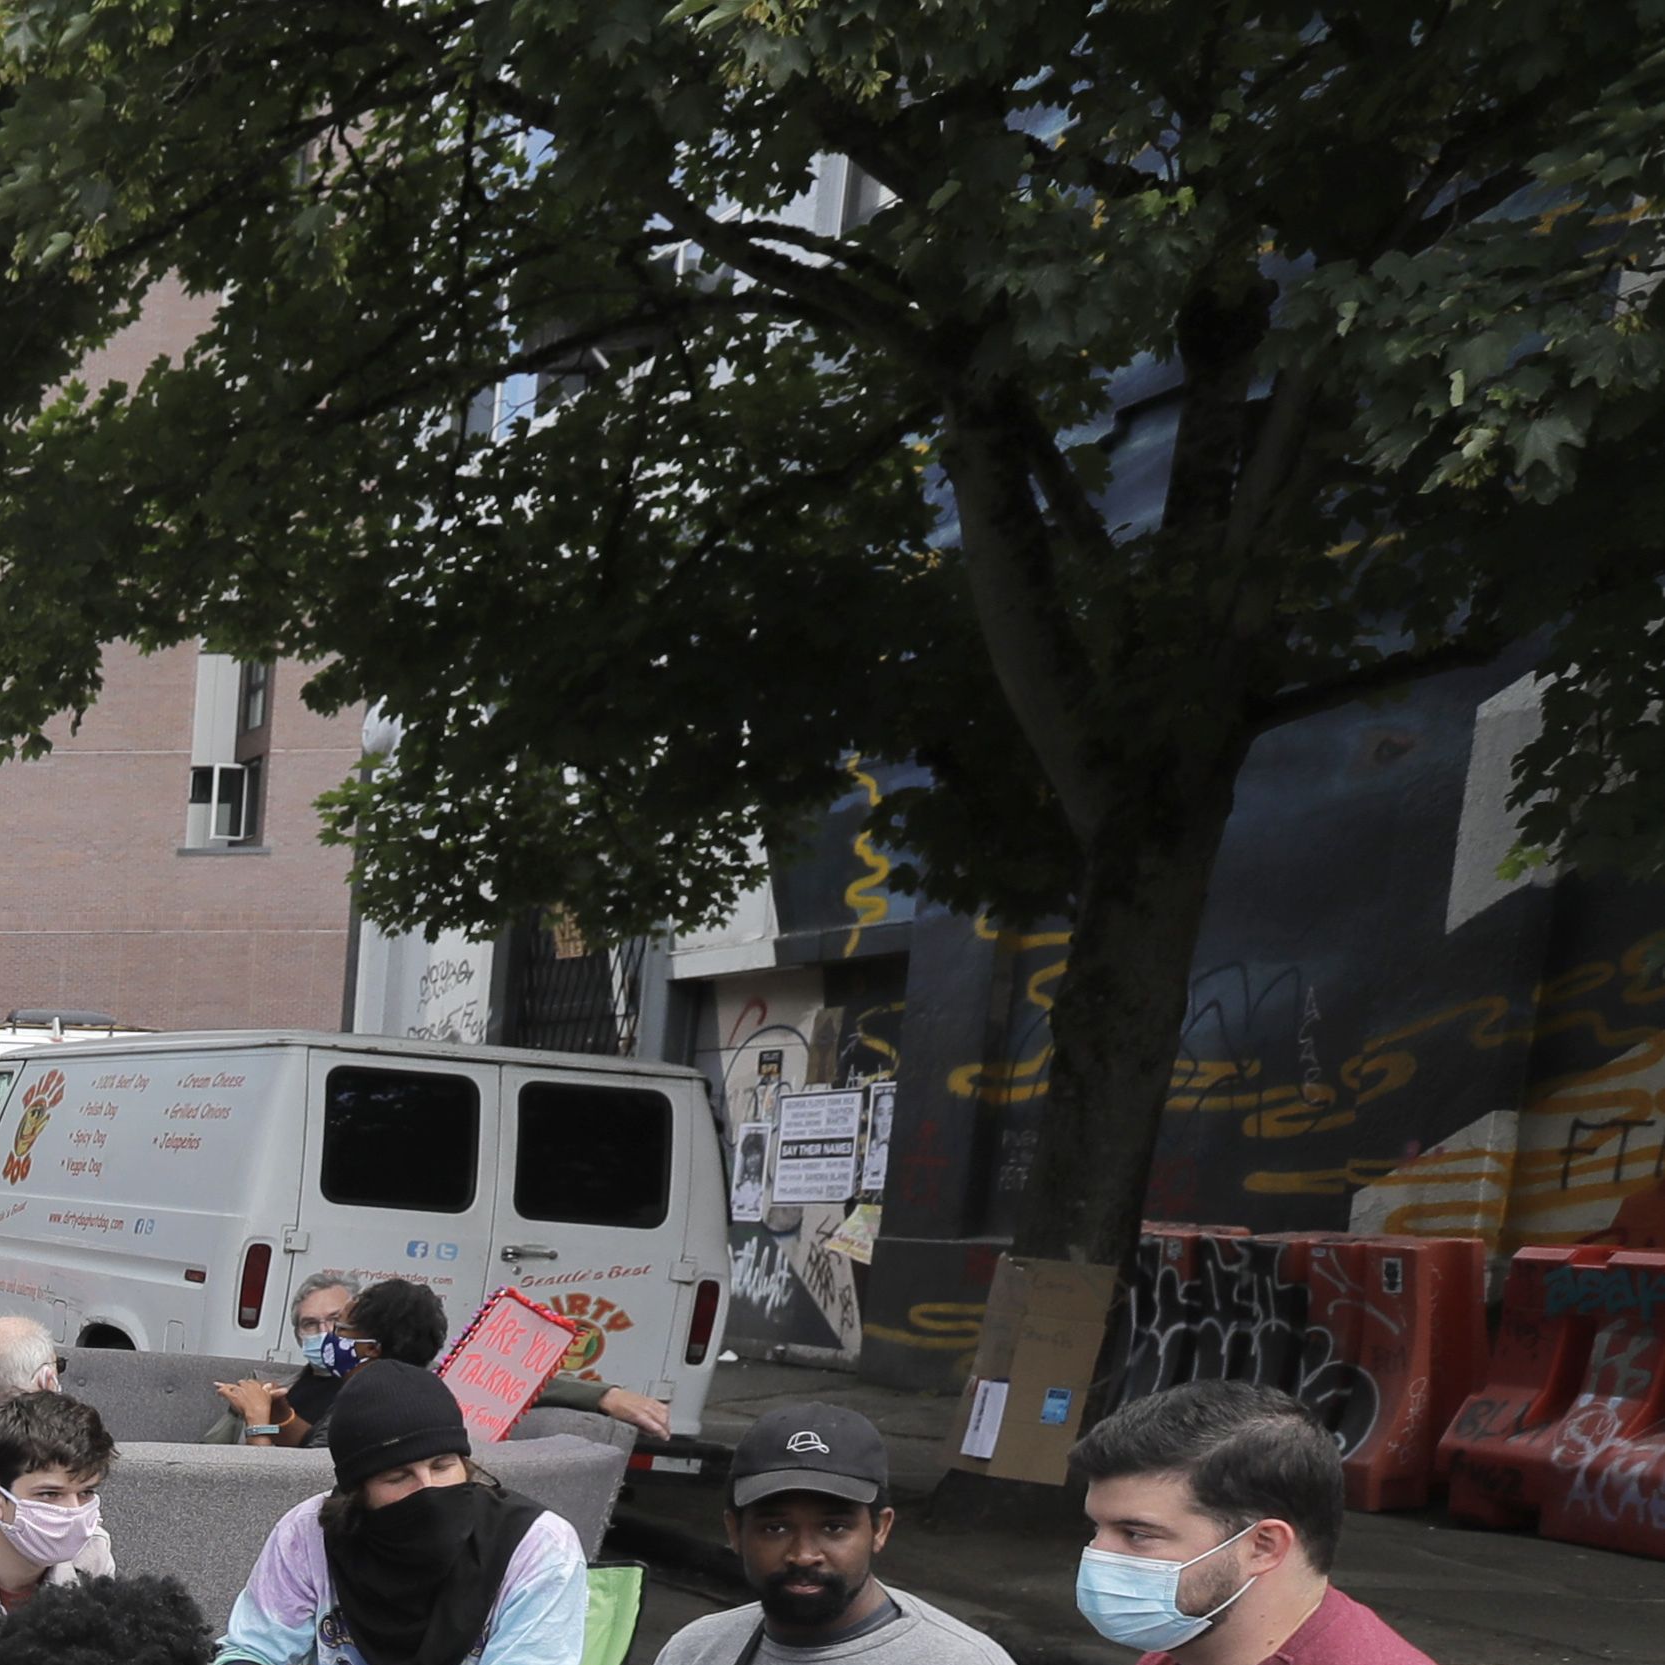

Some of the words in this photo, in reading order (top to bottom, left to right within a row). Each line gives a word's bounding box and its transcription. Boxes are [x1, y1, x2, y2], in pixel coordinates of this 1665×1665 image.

[134, 1074, 150, 1091] Dog
[182, 1074, 210, 1089] Cream
[212, 1073, 246, 1089] Cheese
[103, 1103, 119, 1120] Dog
[169, 1103, 199, 1119] Grilled
[200, 1104, 231, 1119] Onions
[73, 1129, 91, 1148] Spicy
[91, 1131, 107, 1149] Dog
[782, 1145, 798, 1156] SAY
[823, 1142, 852, 1154] NAMES
[2, 1150, 32, 1185] DOG
[87, 1159, 102, 1177] Dog
[607, 1264, 651, 1280] Best
[543, 1293, 634, 1334] IRTY
[470, 1304, 526, 1356] ARE
[521, 1329, 560, 1374] YOU
[454, 1353, 528, 1405] TALKING
